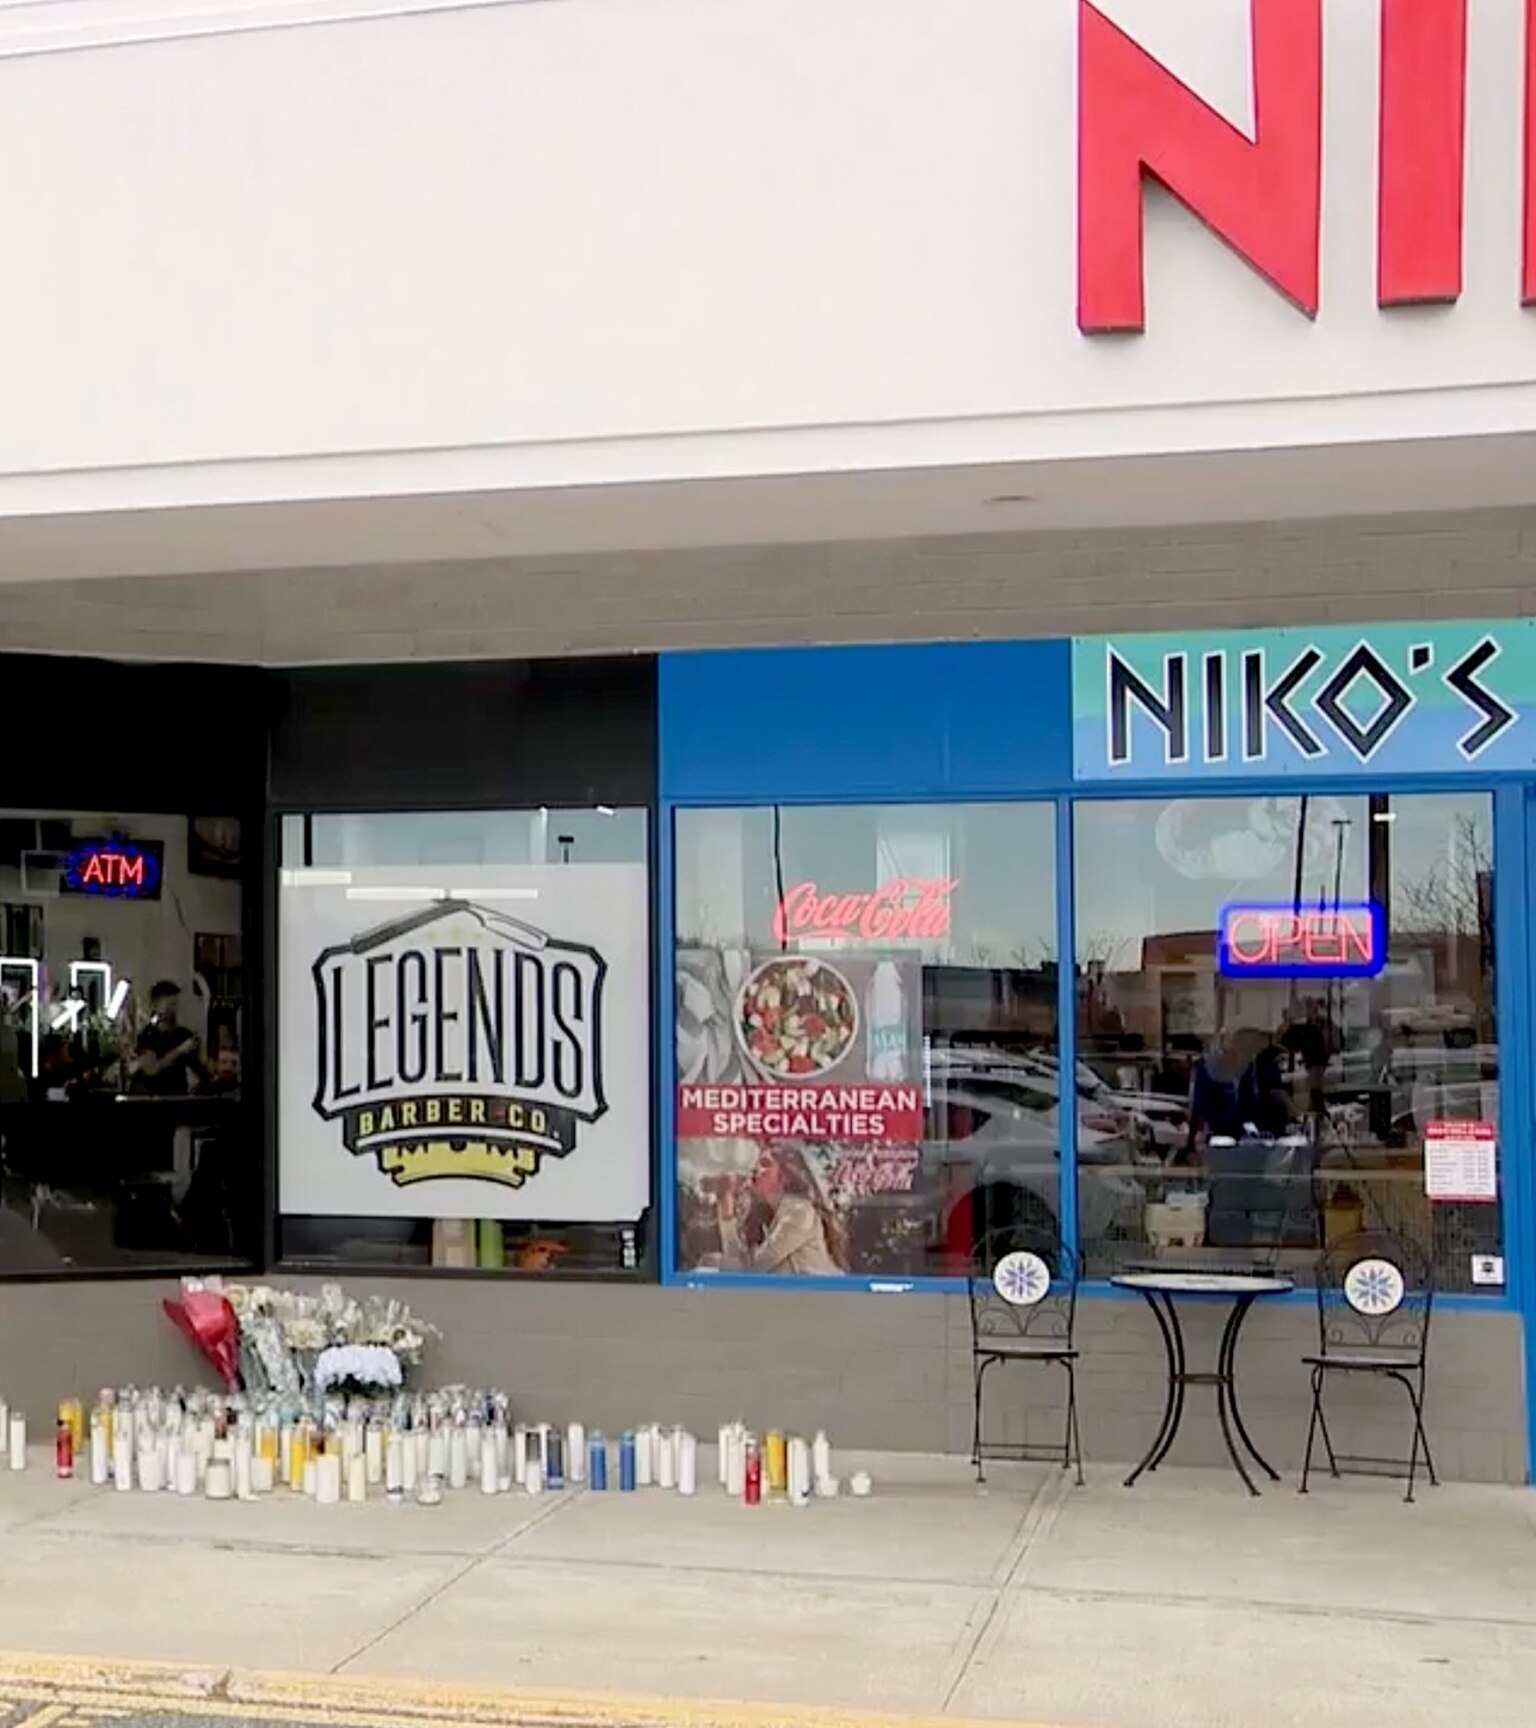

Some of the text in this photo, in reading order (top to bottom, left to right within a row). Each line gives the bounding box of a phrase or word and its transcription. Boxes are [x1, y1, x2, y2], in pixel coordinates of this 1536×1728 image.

[1077, 0, 1536, 335] NI
[1106, 633, 1521, 765] NIKO'S
[83, 853, 143, 885] ATM
[1228, 911, 1373, 963] OPEN
[332, 946, 583, 1101] LEGENDS
[358, 1098, 560, 1139] BARBER CO.
[681, 1088, 916, 1111] MEDITERRANEAN
[713, 1113, 885, 1135] SPECIALTIES
